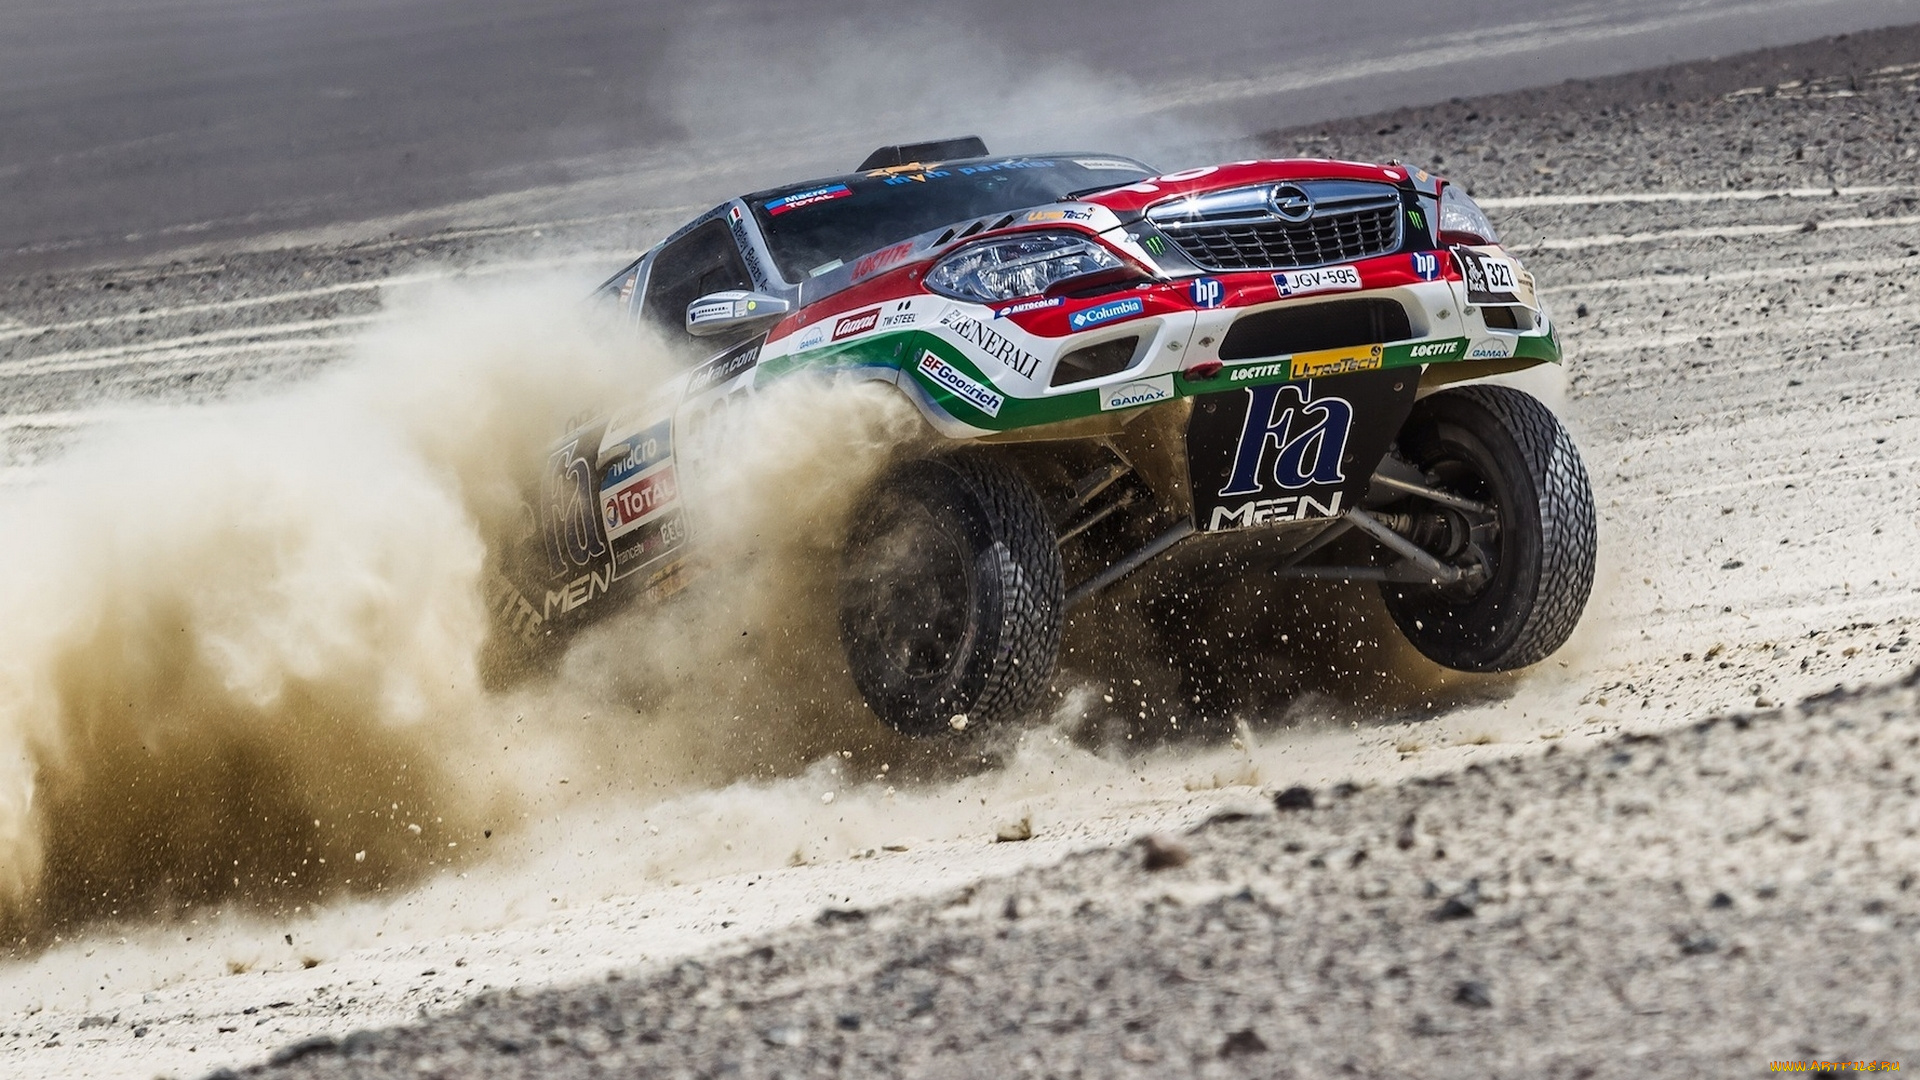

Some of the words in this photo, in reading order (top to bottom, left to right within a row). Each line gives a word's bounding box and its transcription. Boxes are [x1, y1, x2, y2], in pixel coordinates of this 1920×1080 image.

[958, 160, 1055, 176] partner
[784, 189, 828, 202] Macro
[785, 194, 834, 208] TOTAL
[733, 218, 749, 254] Szalay
[851, 241, 914, 281] LOCTITE
[1416, 253, 1437, 281] hp
[1279, 284, 1289, 294] H
[1291, 268, 1358, 289] JGV-595
[1487, 263, 1514, 288] 327
[1012, 298, 1060, 313] AUTOCOLOR
[1196, 279, 1219, 308] hp
[882, 316, 892, 327] TW
[892, 312, 917, 326] STEEL
[1086, 301, 1139, 322] Columbia
[949, 314, 1042, 381] GENERALI
[1410, 342, 1458, 357] LOCTITE
[1472, 349, 1510, 358] GAMAX
[688, 345, 759, 394] dakar.com
[922, 354, 1000, 410] BFGoodrich
[1230, 364, 1282, 381] LOCTITE
[1111, 390, 1165, 407] GAMAX
[1218, 379, 1354, 497] Fa
[619, 478, 676, 518] TOTAL
[1209, 491, 1343, 532] MEN
[544, 562, 611, 621] MEN
